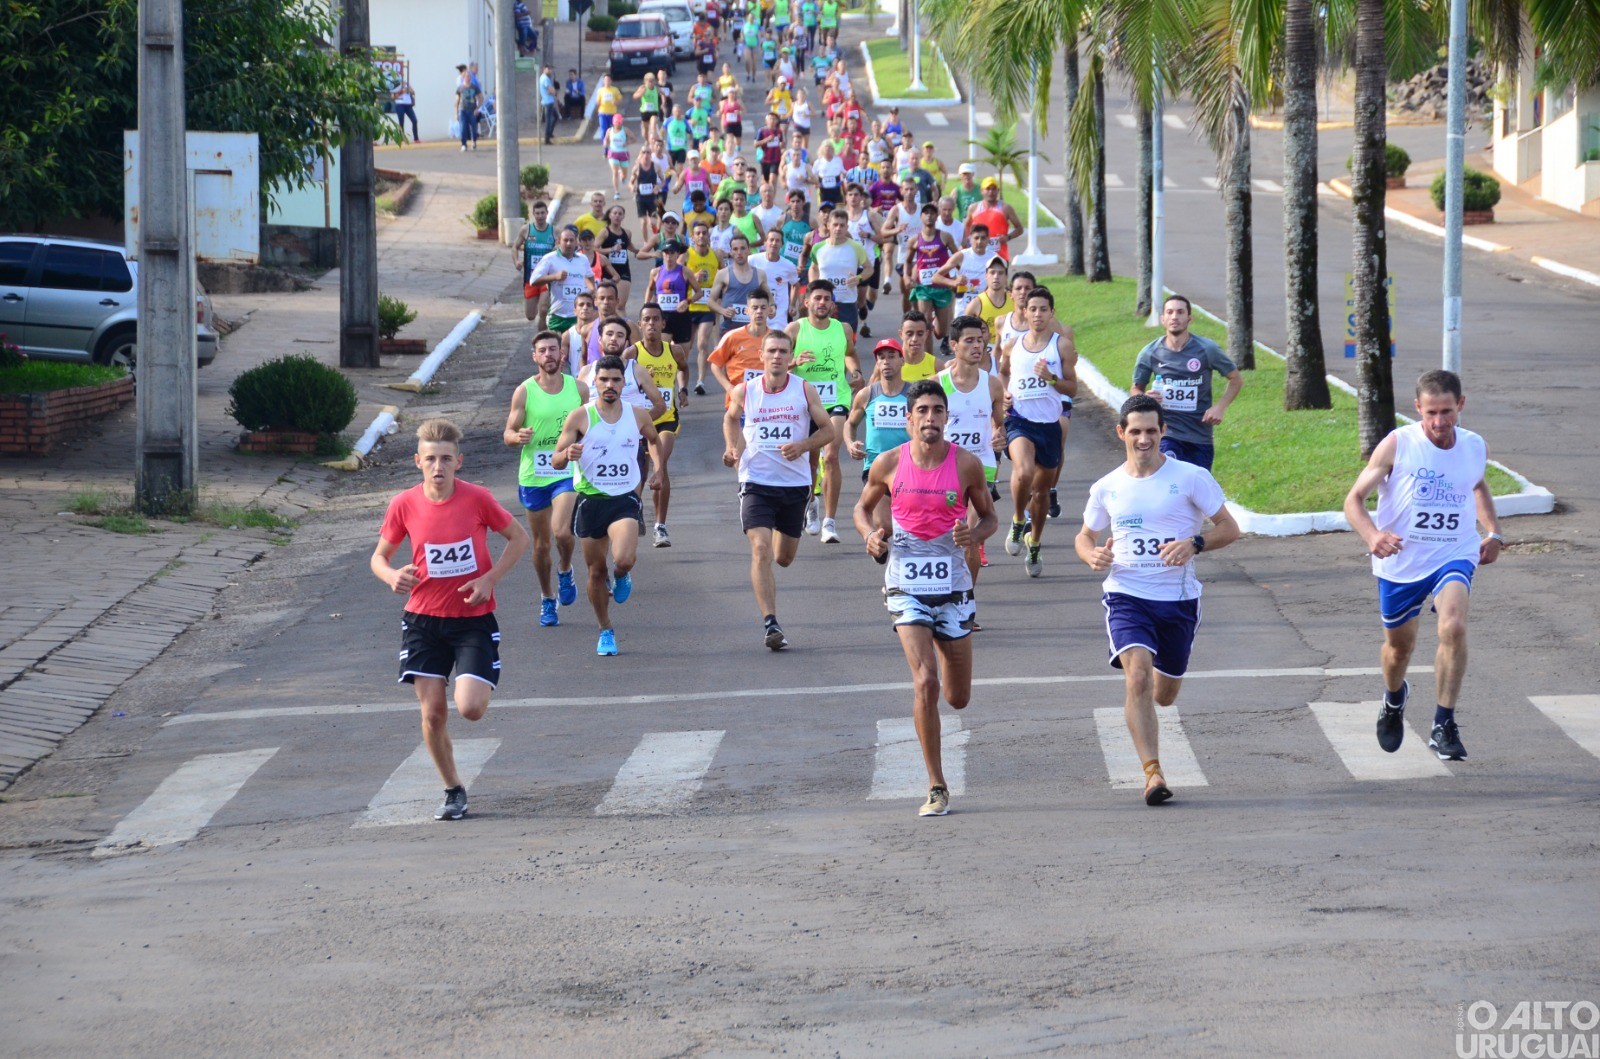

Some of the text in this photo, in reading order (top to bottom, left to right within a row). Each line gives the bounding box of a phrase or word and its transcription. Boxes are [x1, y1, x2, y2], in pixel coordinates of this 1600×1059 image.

[610, 250, 626, 258] 272
[660, 296, 678, 304] 282
[1018, 377, 1047, 389] 328
[1165, 388, 1195, 401] 384
[878, 404, 906, 417] 351
[759, 426, 792, 440] 344
[950, 432, 981, 445] 278
[537, 453, 554, 467] 33
[596, 463, 629, 477] 239
[1437, 480, 1453, 490] Big
[1435, 488, 1467, 503] Beep
[1414, 512, 1460, 530] 235
[429, 544, 472, 564] 242
[904, 561, 949, 580] 348
